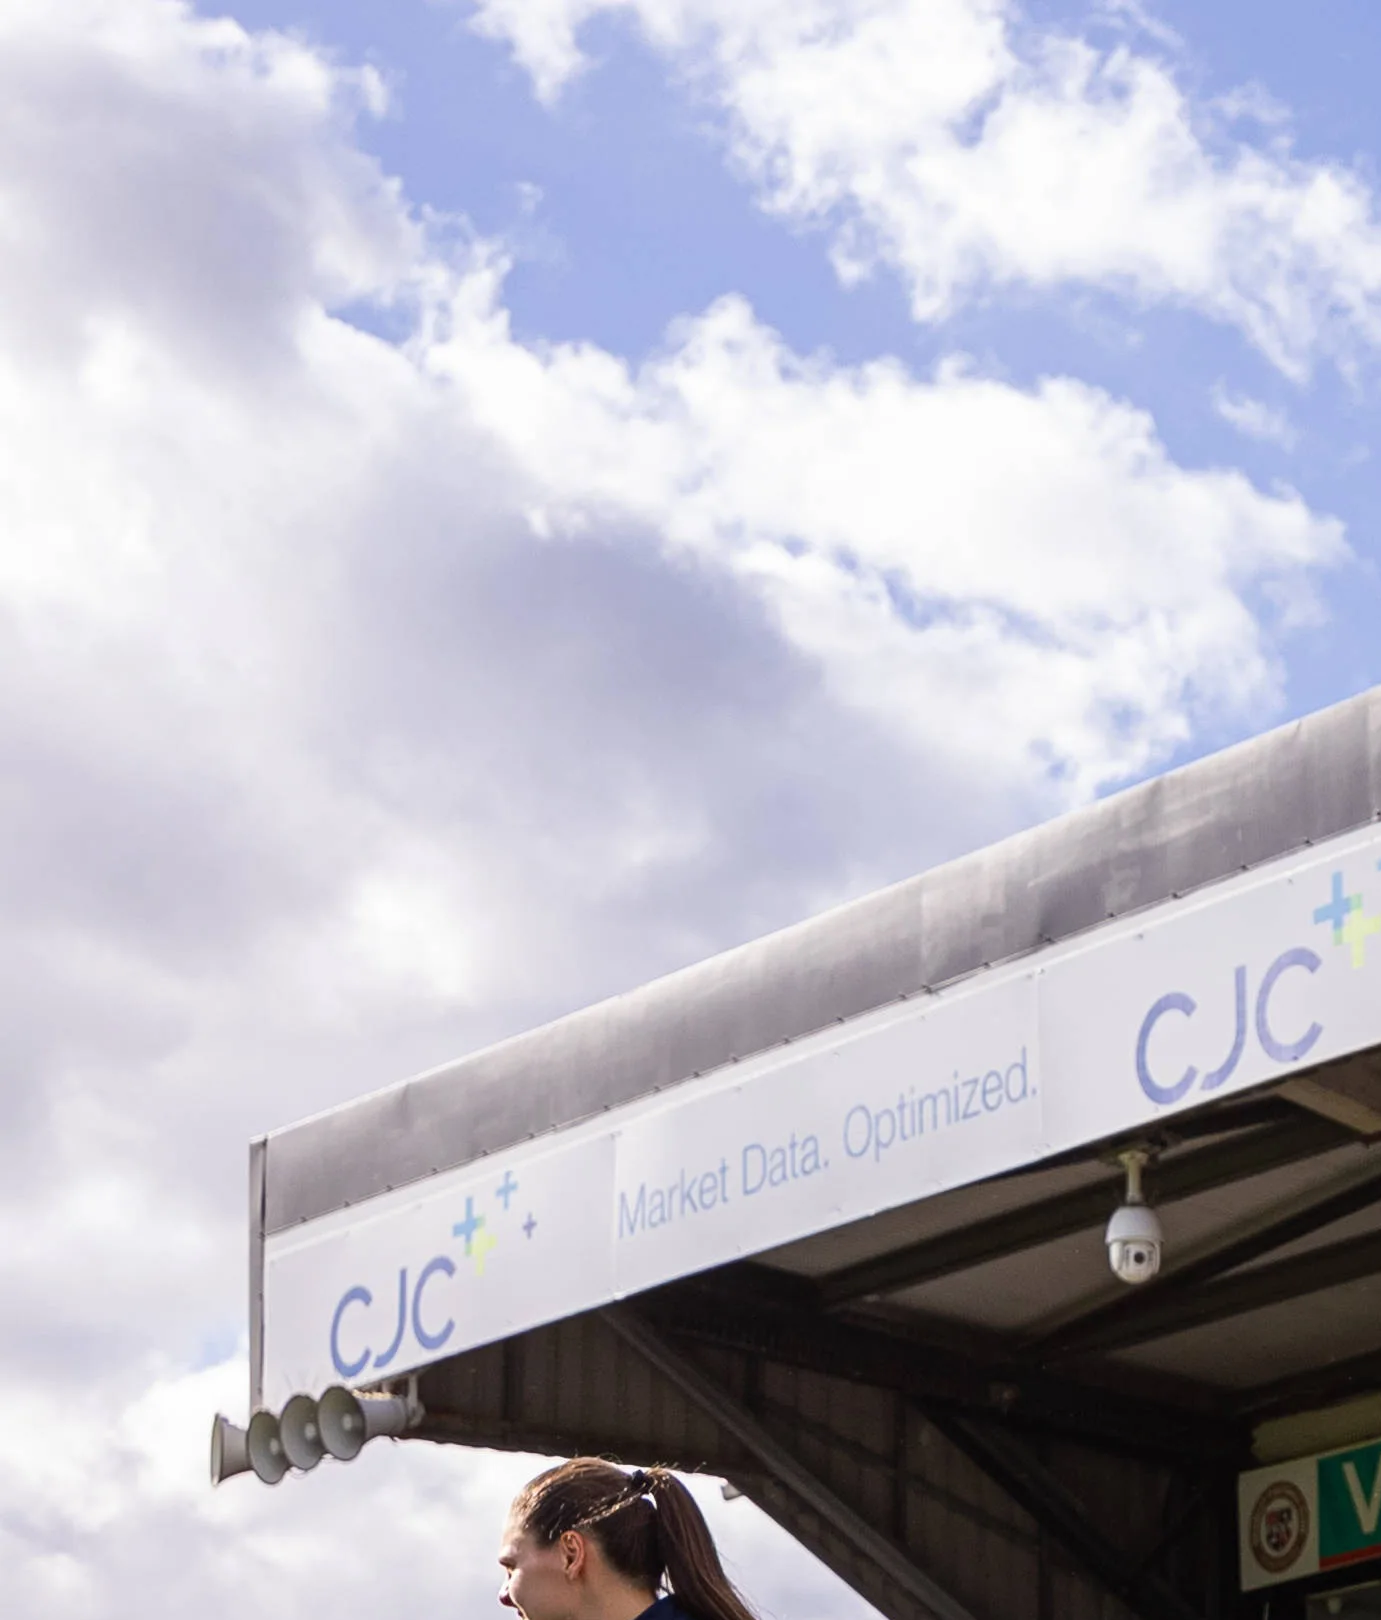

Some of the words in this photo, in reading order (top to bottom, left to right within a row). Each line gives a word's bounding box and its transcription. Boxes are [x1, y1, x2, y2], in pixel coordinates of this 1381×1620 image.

[1136, 947, 1323, 1104] CJC
[619, 1158, 729, 1238] Market
[742, 1130, 829, 1197] Data.
[844, 1046, 1037, 1163] Optimized.
[330, 1256, 456, 1377] CJC
